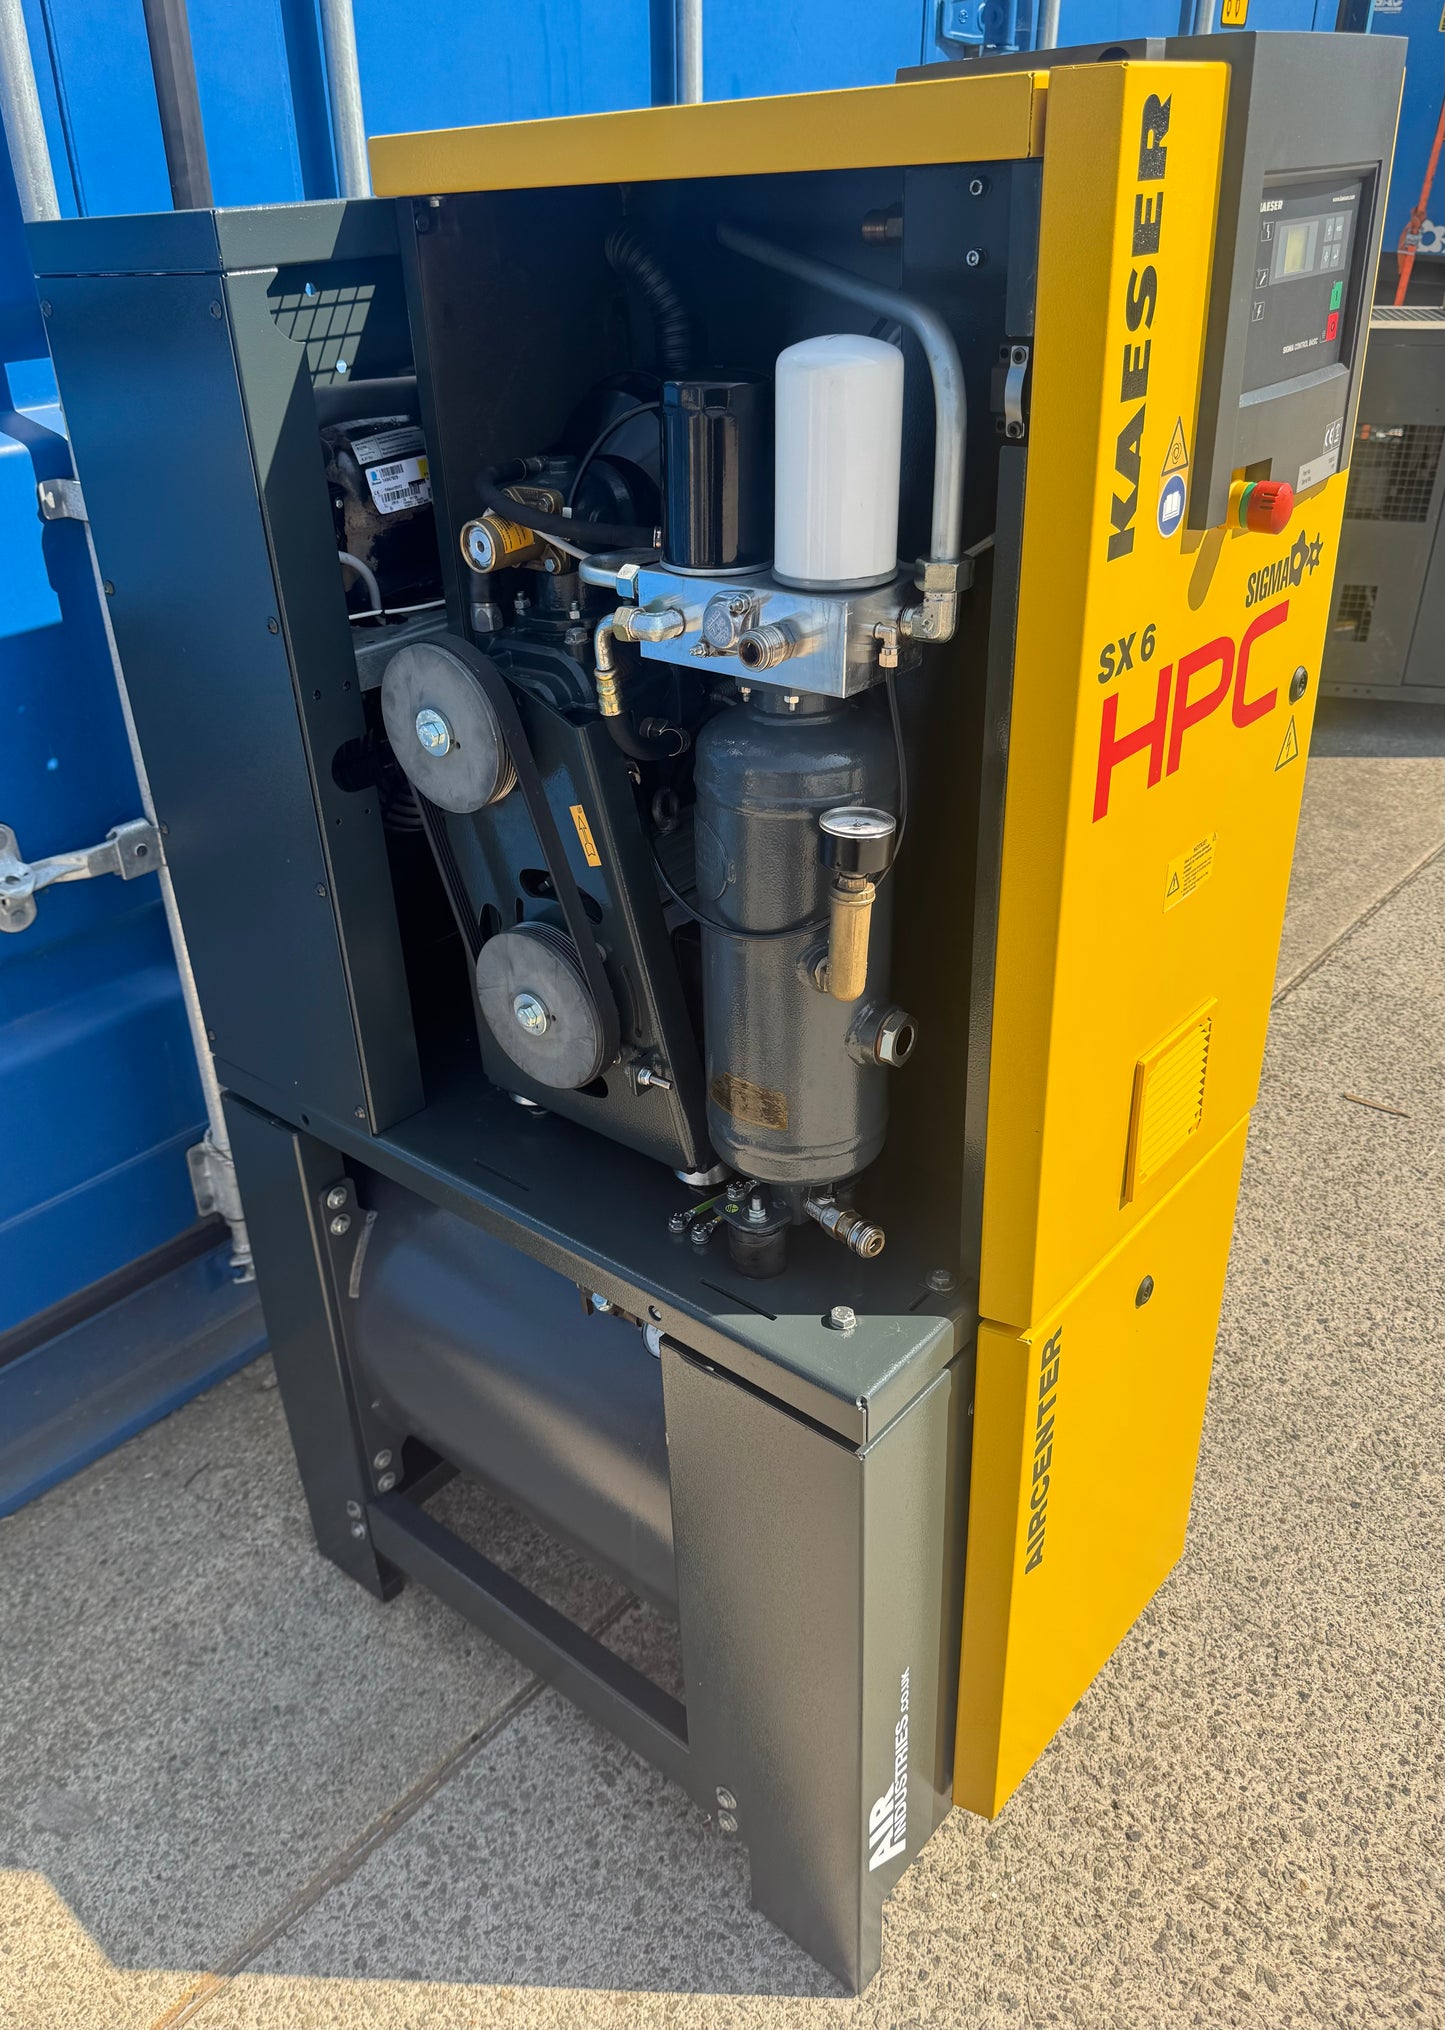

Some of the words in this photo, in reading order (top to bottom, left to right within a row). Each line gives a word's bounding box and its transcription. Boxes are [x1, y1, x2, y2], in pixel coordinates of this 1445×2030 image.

[1107, 93, 1172, 562] KAESER
[1098, 632, 1137, 684] SX
[1140, 623, 1157, 662] 6
[1245, 556, 1290, 608] SIGMA
[1092, 599, 1290, 823] HPC
[1025, 1326, 1063, 1575] AIRCENTER
[869, 1782, 906, 1872] AIR
